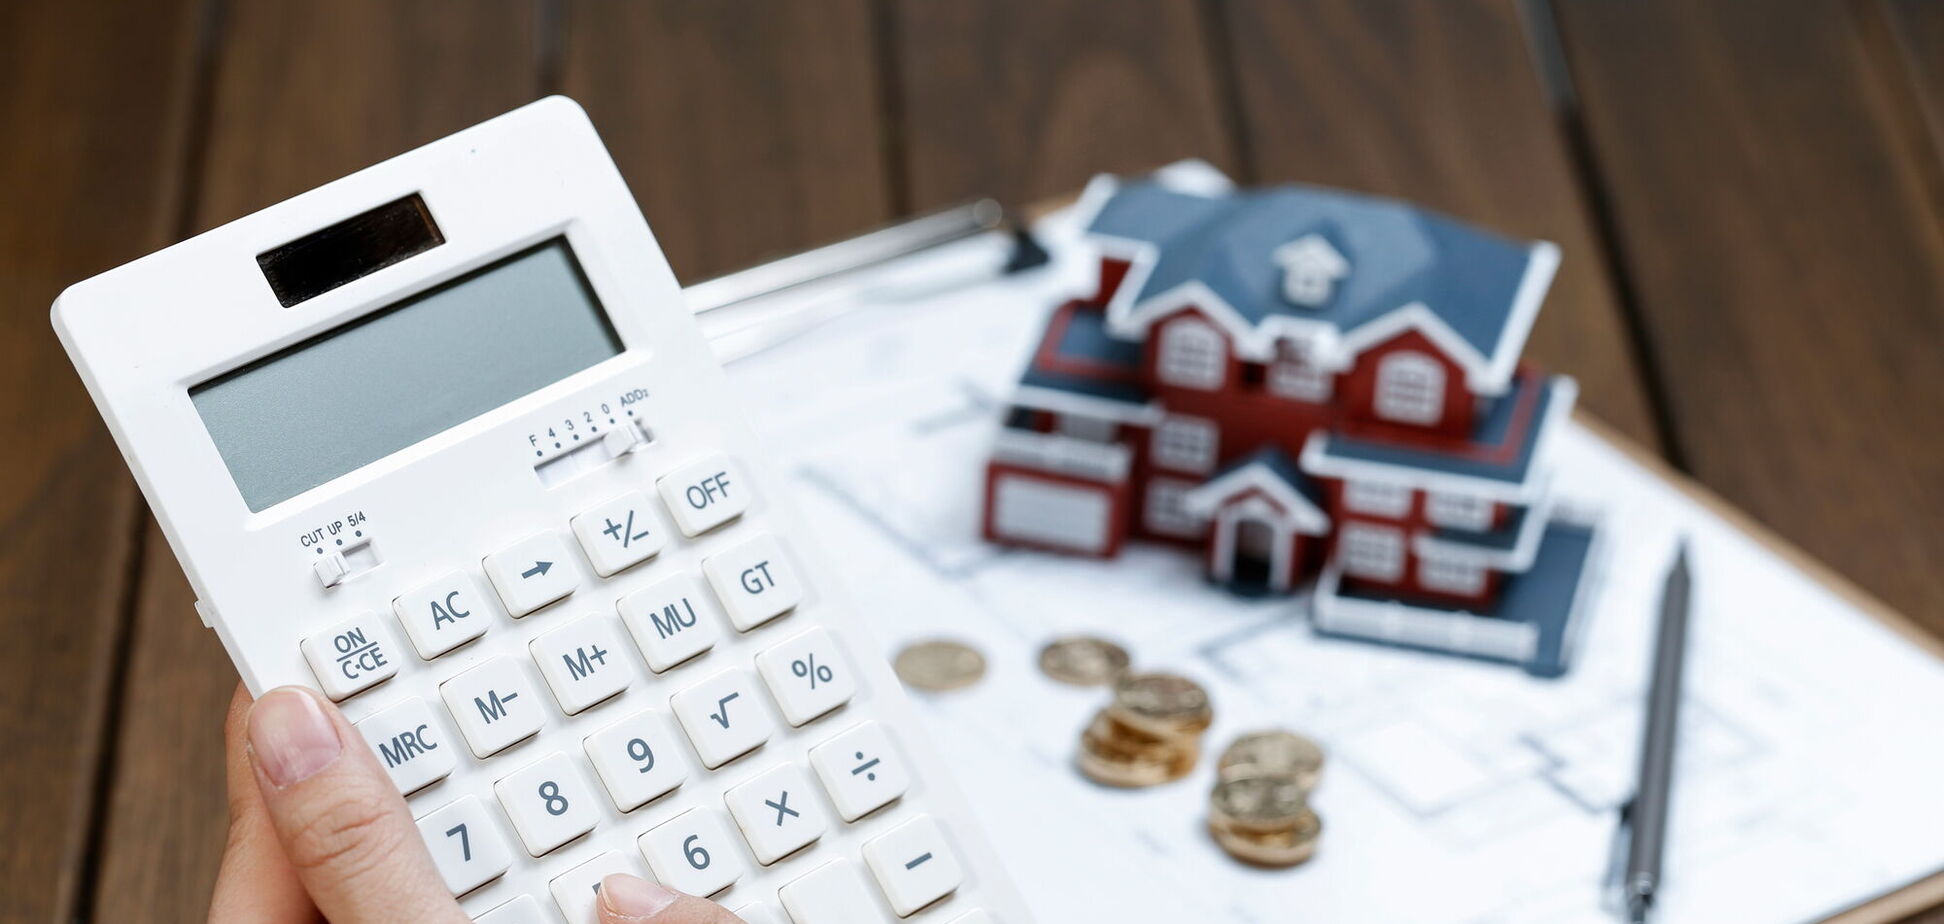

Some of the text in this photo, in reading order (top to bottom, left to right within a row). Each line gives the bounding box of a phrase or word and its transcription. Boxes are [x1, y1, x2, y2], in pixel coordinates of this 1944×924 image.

[528, 434, 537, 447] F
[548, 427, 556, 438] 4
[564, 419, 575, 431] 3
[583, 411, 593, 423] 2
[686, 471, 731, 510] OFF
[300, 510, 366, 548] CUT UP 5/4
[740, 560, 775, 595] GT
[430, 591, 471, 631] AC
[650, 597, 697, 640] MU
[333, 626, 367, 654] ON
[562, 644, 608, 682] M+
[791, 653, 834, 690] %
[378, 724, 438, 769] MRC
[626, 737, 655, 774] 9
[538, 780, 569, 817] 8
[445, 822, 472, 862] 7
[682, 834, 711, 871] 6
